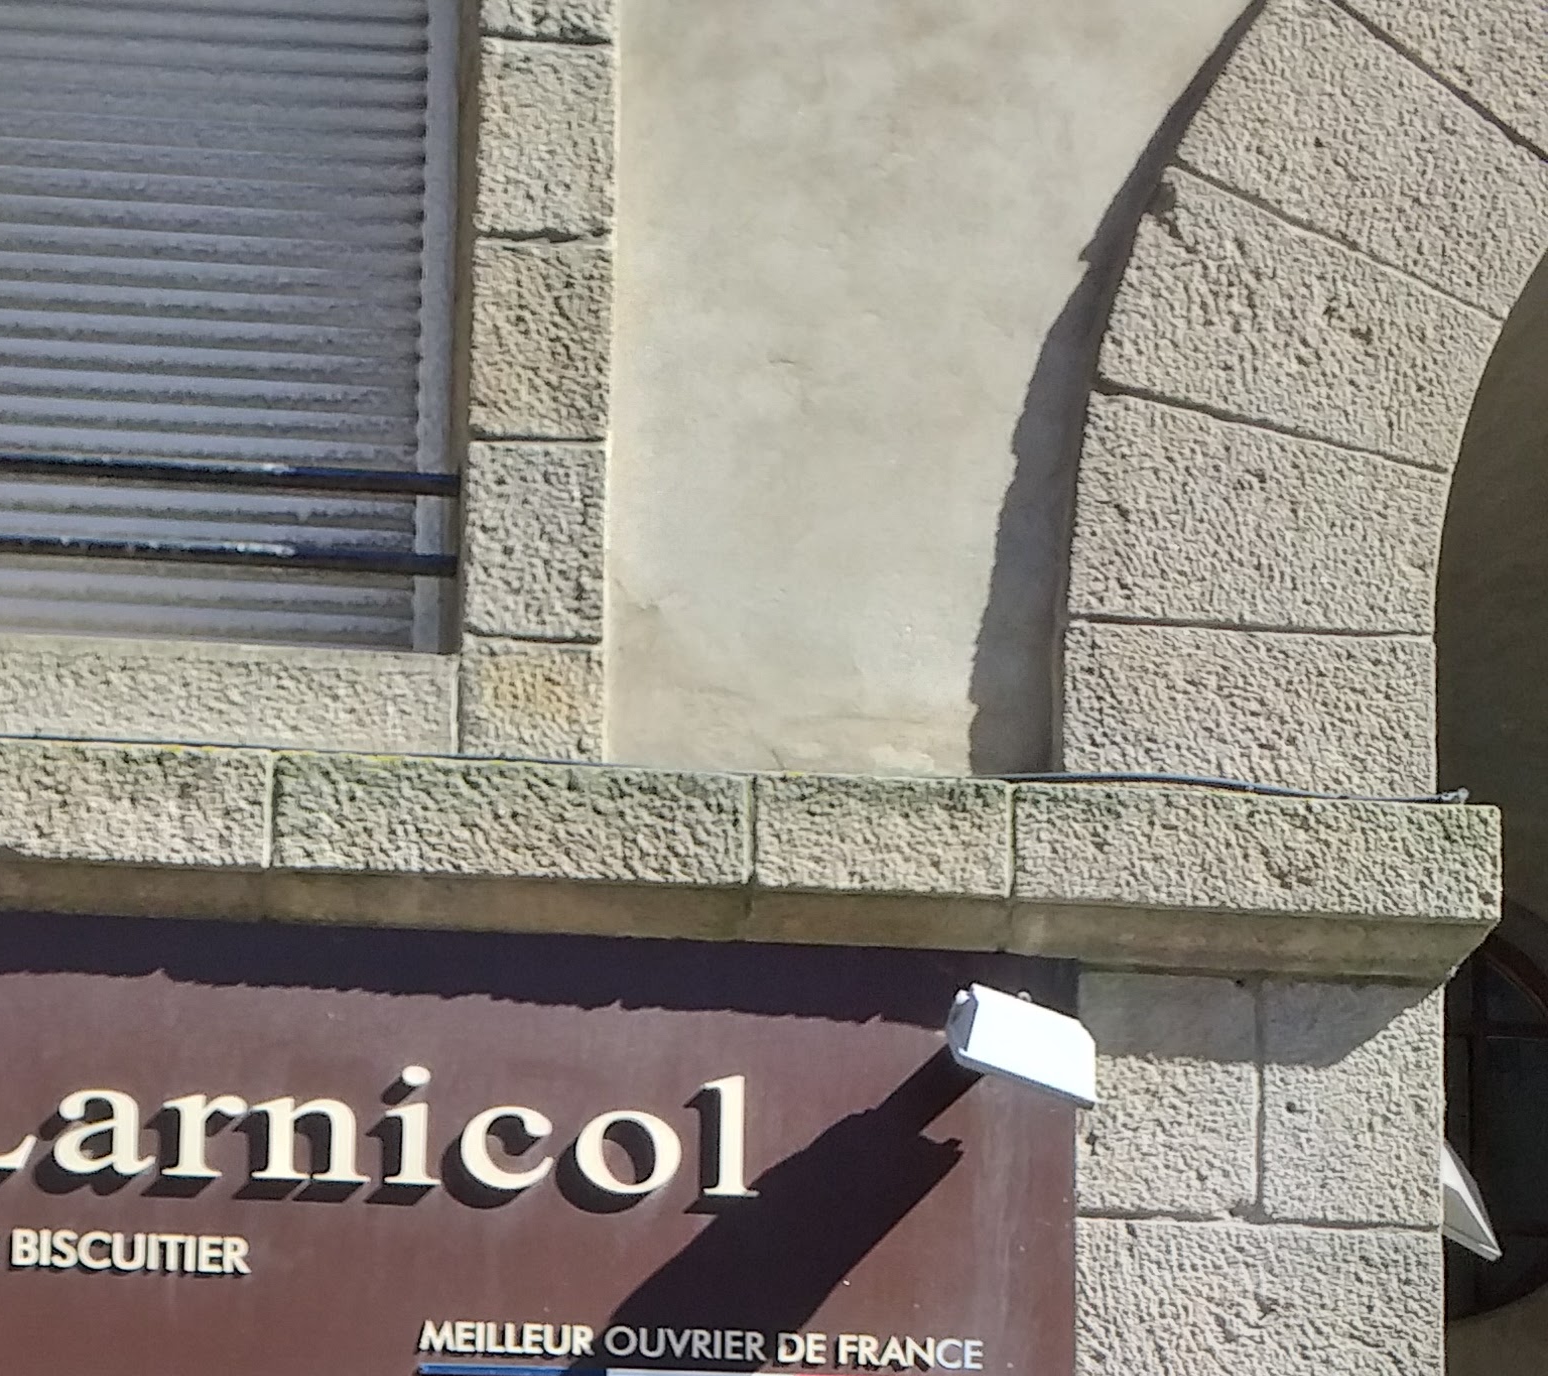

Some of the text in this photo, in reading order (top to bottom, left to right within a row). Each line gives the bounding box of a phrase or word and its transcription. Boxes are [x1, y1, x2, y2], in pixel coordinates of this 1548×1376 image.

[12, 1228, 252, 1274] BISCUITIER
[419, 1319, 984, 1370] MEILLEUR OUVRIER DE FRANCE
